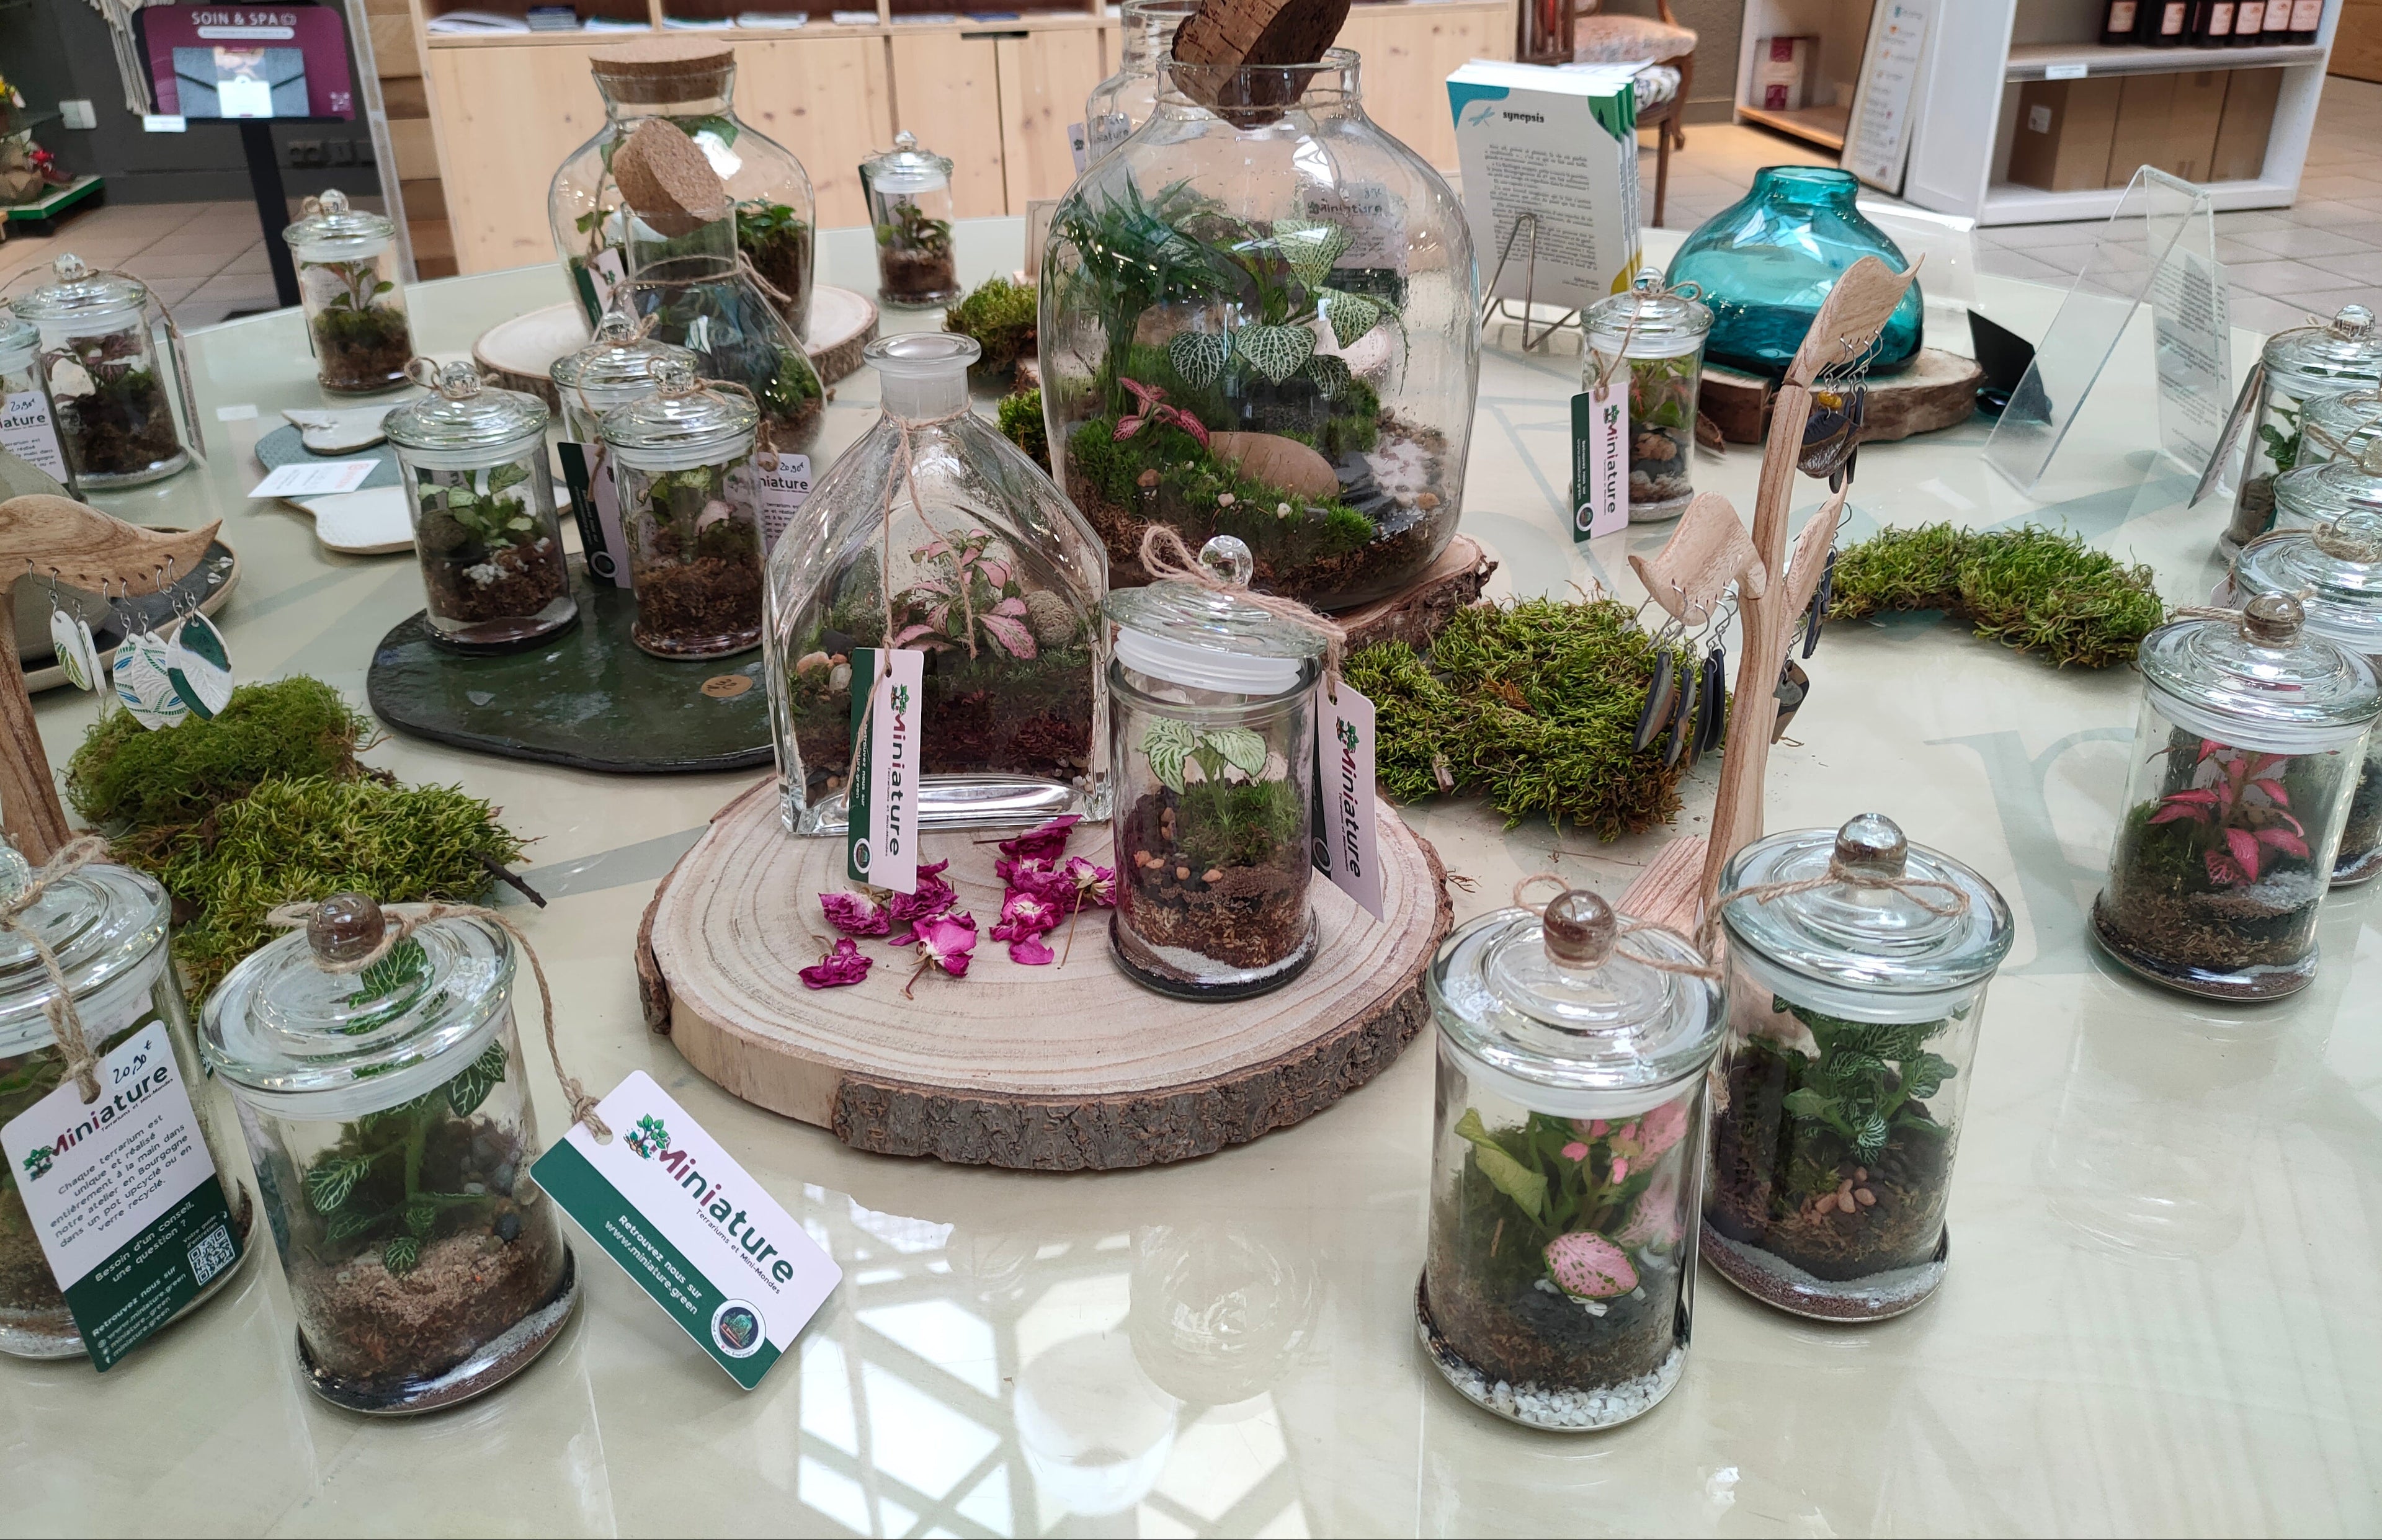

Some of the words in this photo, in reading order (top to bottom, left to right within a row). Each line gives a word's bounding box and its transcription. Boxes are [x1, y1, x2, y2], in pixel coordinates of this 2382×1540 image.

[192, 12, 229, 25] SOIN
[234, 12, 244, 25] &
[249, 12, 278, 25] SPA
[1502, 111, 1545, 124] synopsis
[1606, 418, 1617, 512] Miniature
[890, 705, 906, 855] Miniature
[1339, 738, 1360, 877] Miniature
[113, 1040, 151, 1084] 20,90€
[42, 1067, 167, 1164] Miniature
[101, 1110, 130, 1131] Terrariums
[140, 1078, 173, 1103] Mini-Mondes
[50, 1178, 112, 1227] entièrement
[125, 1162, 134, 1171] la
[138, 1143, 160, 1162] main
[164, 1124, 184, 1142] dans
[55, 1214, 83, 1237] notre
[88, 1187, 118, 1213] atelier
[123, 1176, 135, 1186] en
[138, 1136, 187, 1175] Bourgogne
[58, 1165, 95, 1194] Chaque
[99, 1129, 144, 1164] terrarium
[148, 1115, 163, 1128] est
[74, 1170, 106, 1196] unique
[111, 1158, 122, 1168] et
[125, 1132, 155, 1158] réalisé
[60, 1227, 84, 1247] dans
[87, 1215, 100, 1226] un
[104, 1199, 121, 1216] pot
[125, 1167, 161, 1198] upcyclé
[165, 1156, 177, 1167] ou
[180, 1145, 192, 1155] en
[97, 1210, 124, 1231] verre
[128, 1179, 165, 1209] recyclé.
[649, 1136, 793, 1283] Miniature
[95, 1252, 130, 1281] Besoin
[133, 1232, 154, 1251] d'un
[112, 1265, 131, 1281] une
[136, 1228, 177, 1263] question
[182, 1229, 199, 1242] Votre
[605, 1221, 697, 1314] www.miniature.green
[618, 1215, 663, 1262] Retrouvez
[664, 1262, 685, 1283] nous
[687, 1284, 702, 1298] sur
[696, 1208, 729, 1244] Terrariums
[731, 1245, 739, 1253] et
[740, 1253, 779, 1294] Mini-Mondes
[92, 1297, 137, 1337] Retrouvez
[140, 1279, 160, 1297] nous
[164, 1266, 175, 1278] sur
[107, 1273, 185, 1338] www.miniature.green
[110, 1296, 170, 1348] miniature_green
[113, 1307, 169, 1356] miniature.green
